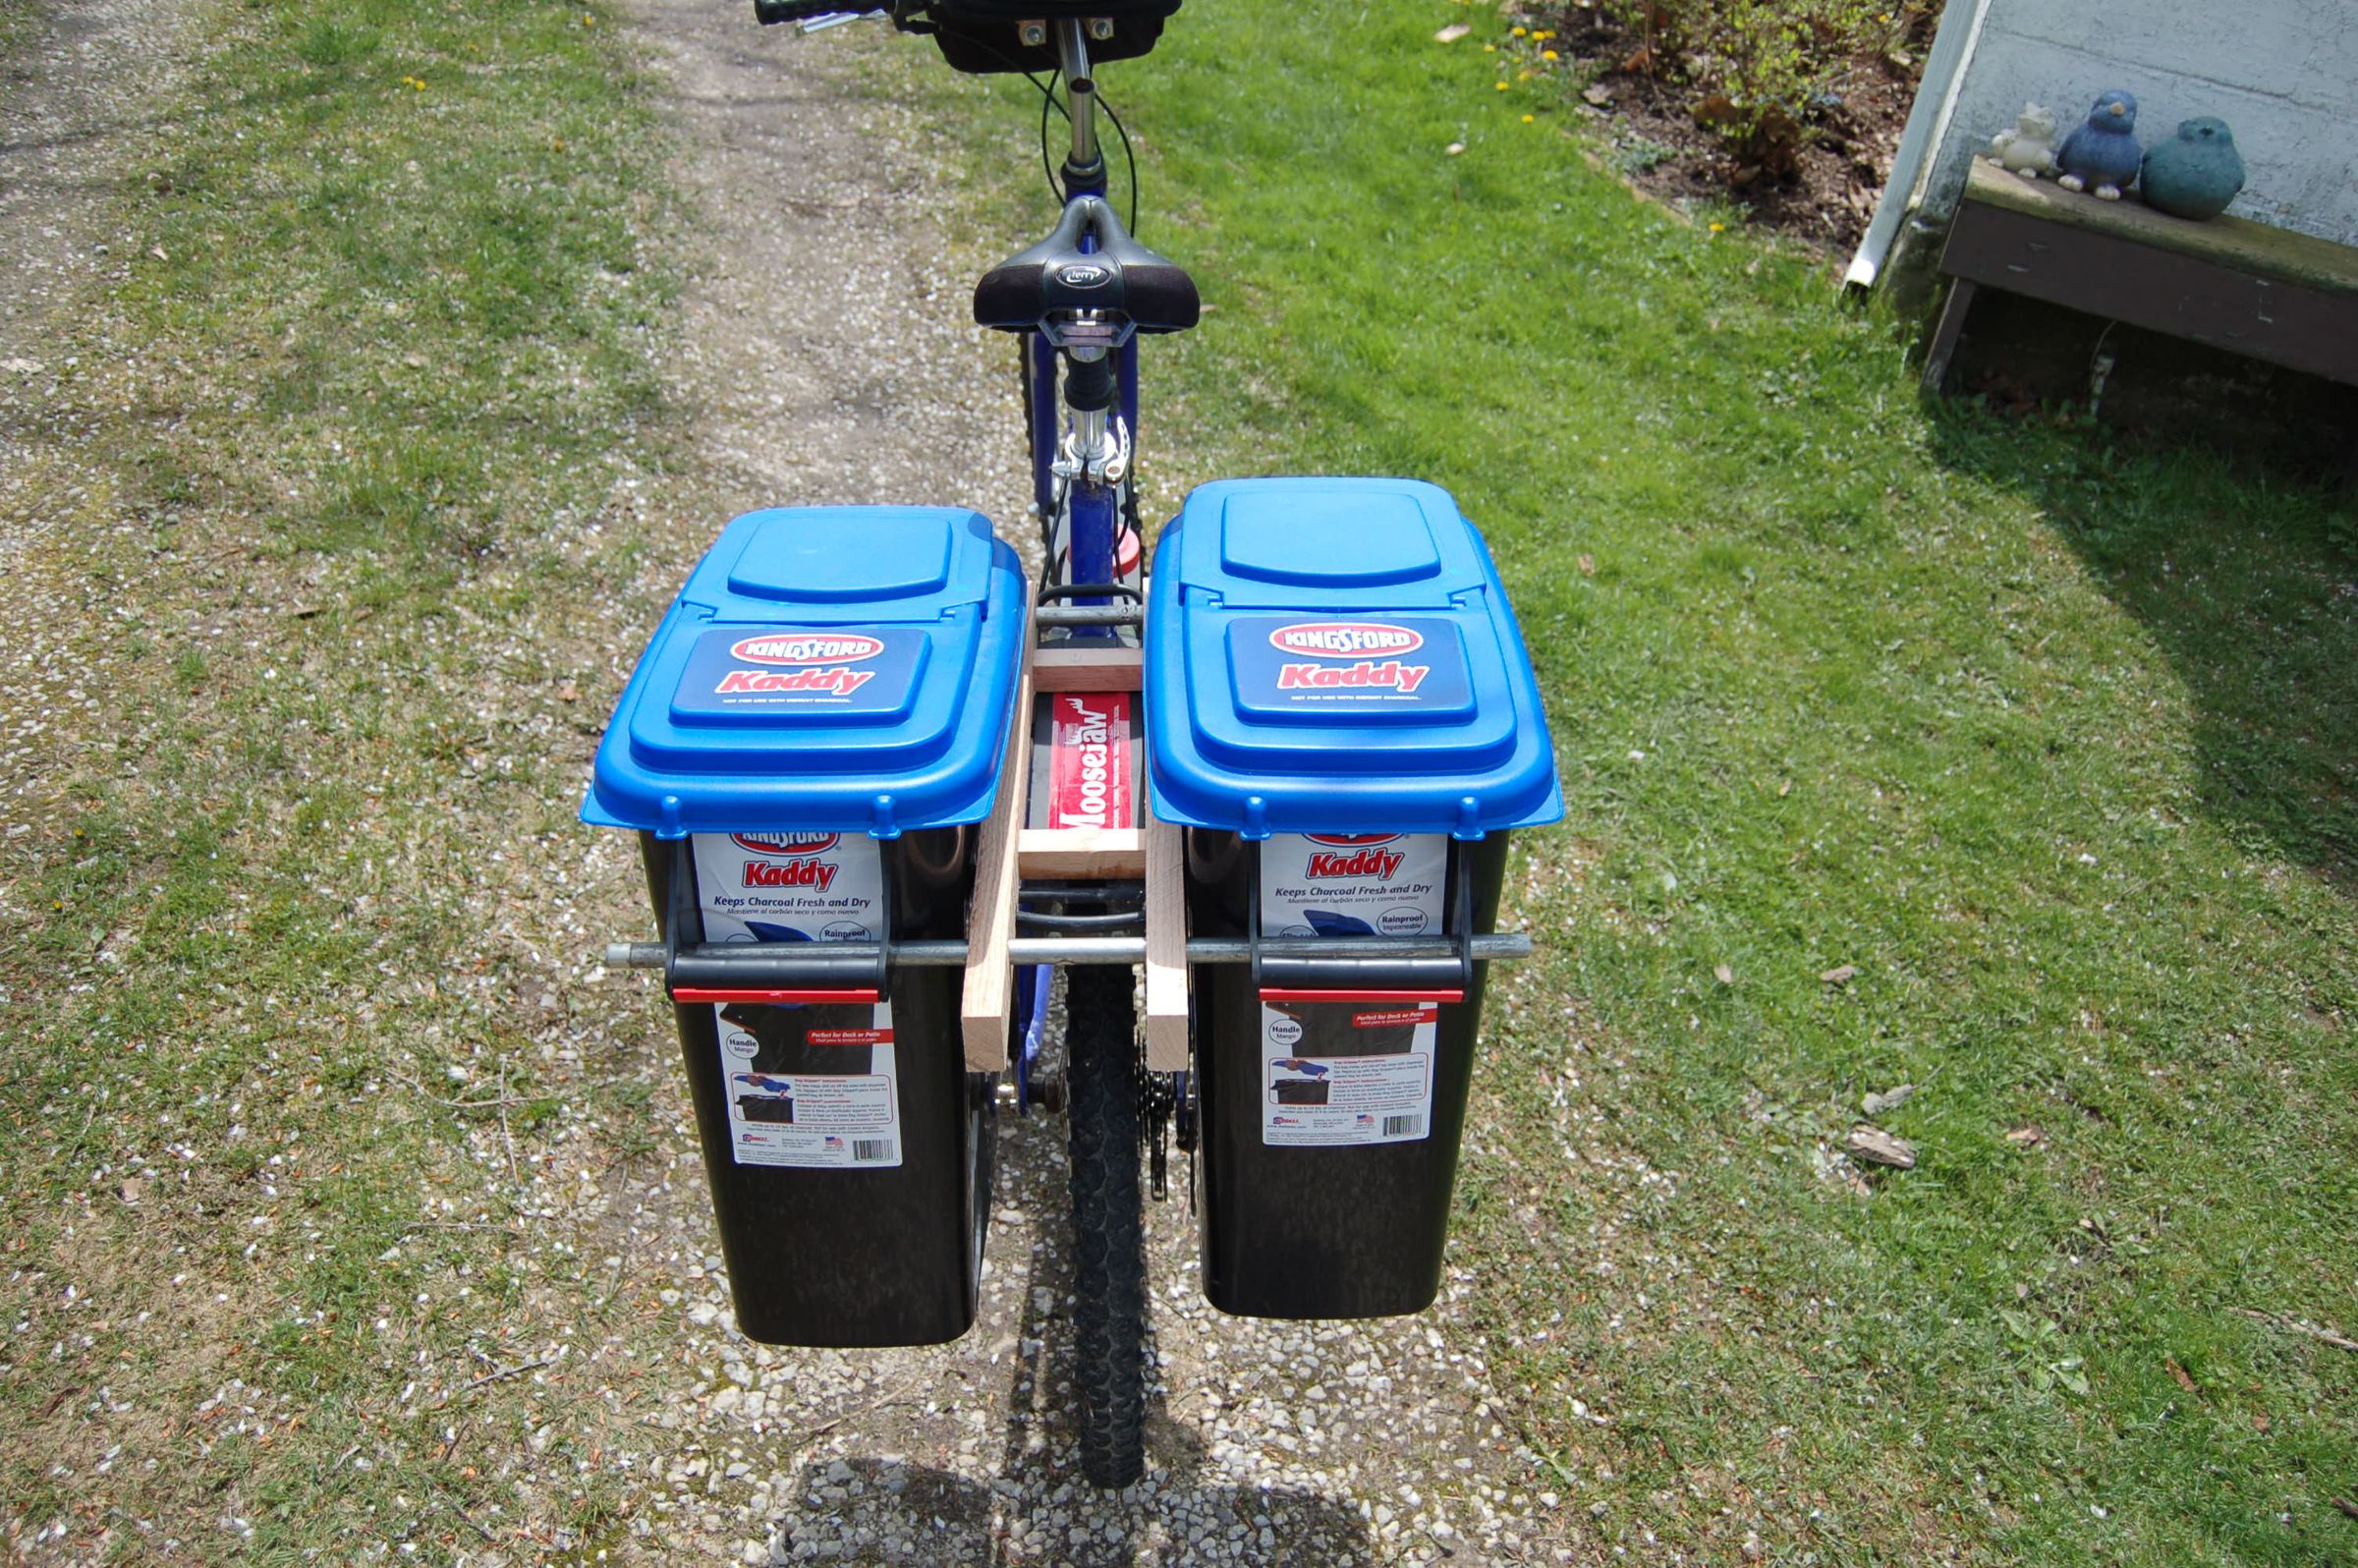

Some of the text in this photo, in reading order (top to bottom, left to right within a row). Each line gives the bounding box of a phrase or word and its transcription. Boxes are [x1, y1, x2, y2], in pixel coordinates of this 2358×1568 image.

[745, 640, 872, 660] KINGSFORD
[1284, 629, 1412, 652] KINGSFORD
[715, 667, 875, 696] Kaddy
[1277, 660, 1430, 692] Kaddy
[1305, 846, 1406, 880] Kaddy
[742, 858, 839, 893] Kaddy
[1275, 883, 1432, 898] Keeps Charcoal Fresh and Dry
[714, 896, 870, 909] Keeps Charcoal Fresh and Dry
[1382, 915, 1423, 924] Rainproof
[824, 929, 866, 938] Rainproof
[729, 1038, 757, 1047] Handle
